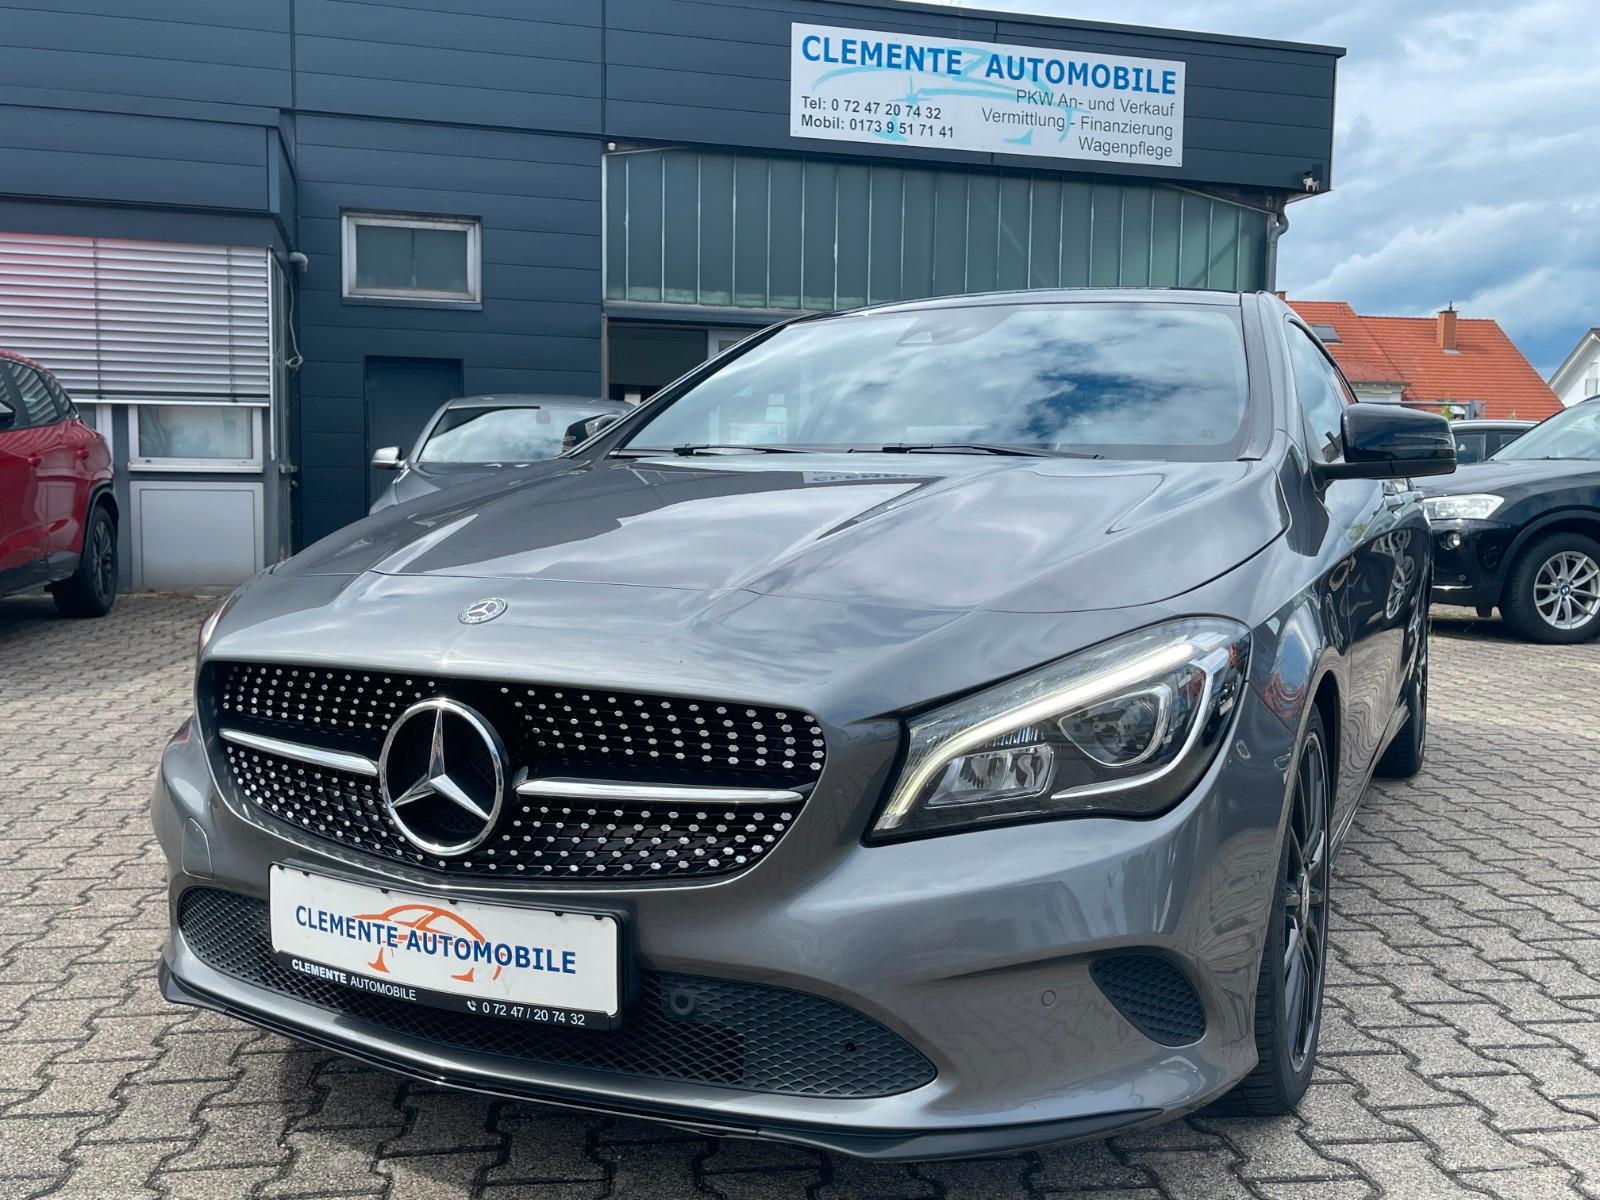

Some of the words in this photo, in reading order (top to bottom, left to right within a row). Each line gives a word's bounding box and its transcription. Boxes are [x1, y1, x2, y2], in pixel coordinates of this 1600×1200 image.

[801, 35, 962, 75] CLEMENTE
[985, 55, 1176, 95] AUTOMOBILE
[801, 96, 826, 110] Tel:
[831, 98, 839, 111] 0
[844, 100, 860, 113] 72
[864, 102, 880, 115] 47
[885, 103, 901, 116] 20
[905, 105, 921, 118] 74
[925, 107, 941, 120] 32
[1016, 89, 1054, 106] PKW
[1057, 93, 1084, 108] An-
[1088, 98, 1115, 112] und
[1119, 99, 1175, 117] Verkauf
[801, 114, 845, 130] Mobil:
[849, 118, 882, 133] 0173
[886, 121, 894, 133] 9
[899, 123, 914, 135] 51
[919, 124, 934, 137] 71
[939, 126, 954, 139] 41
[981, 107, 1065, 131] Vermittlung
[1080, 116, 1173, 140] Finanzierung
[1078, 136, 1173, 160] Wagenpflege
[295, 905, 398, 948] CLEMENTE
[406, 930, 576, 974] AUTOMOBILE
[291, 958, 348, 984] CLEMENTE
[350, 975, 417, 1001] AUTOMOBILE
[482, 1001, 490, 1013] 0
[493, 1003, 507, 1016] 72
[510, 1006, 524, 1018] 47
[533, 1008, 549, 1021] 20
[552, 1010, 566, 1023] 74
[570, 1013, 585, 1026] 32
